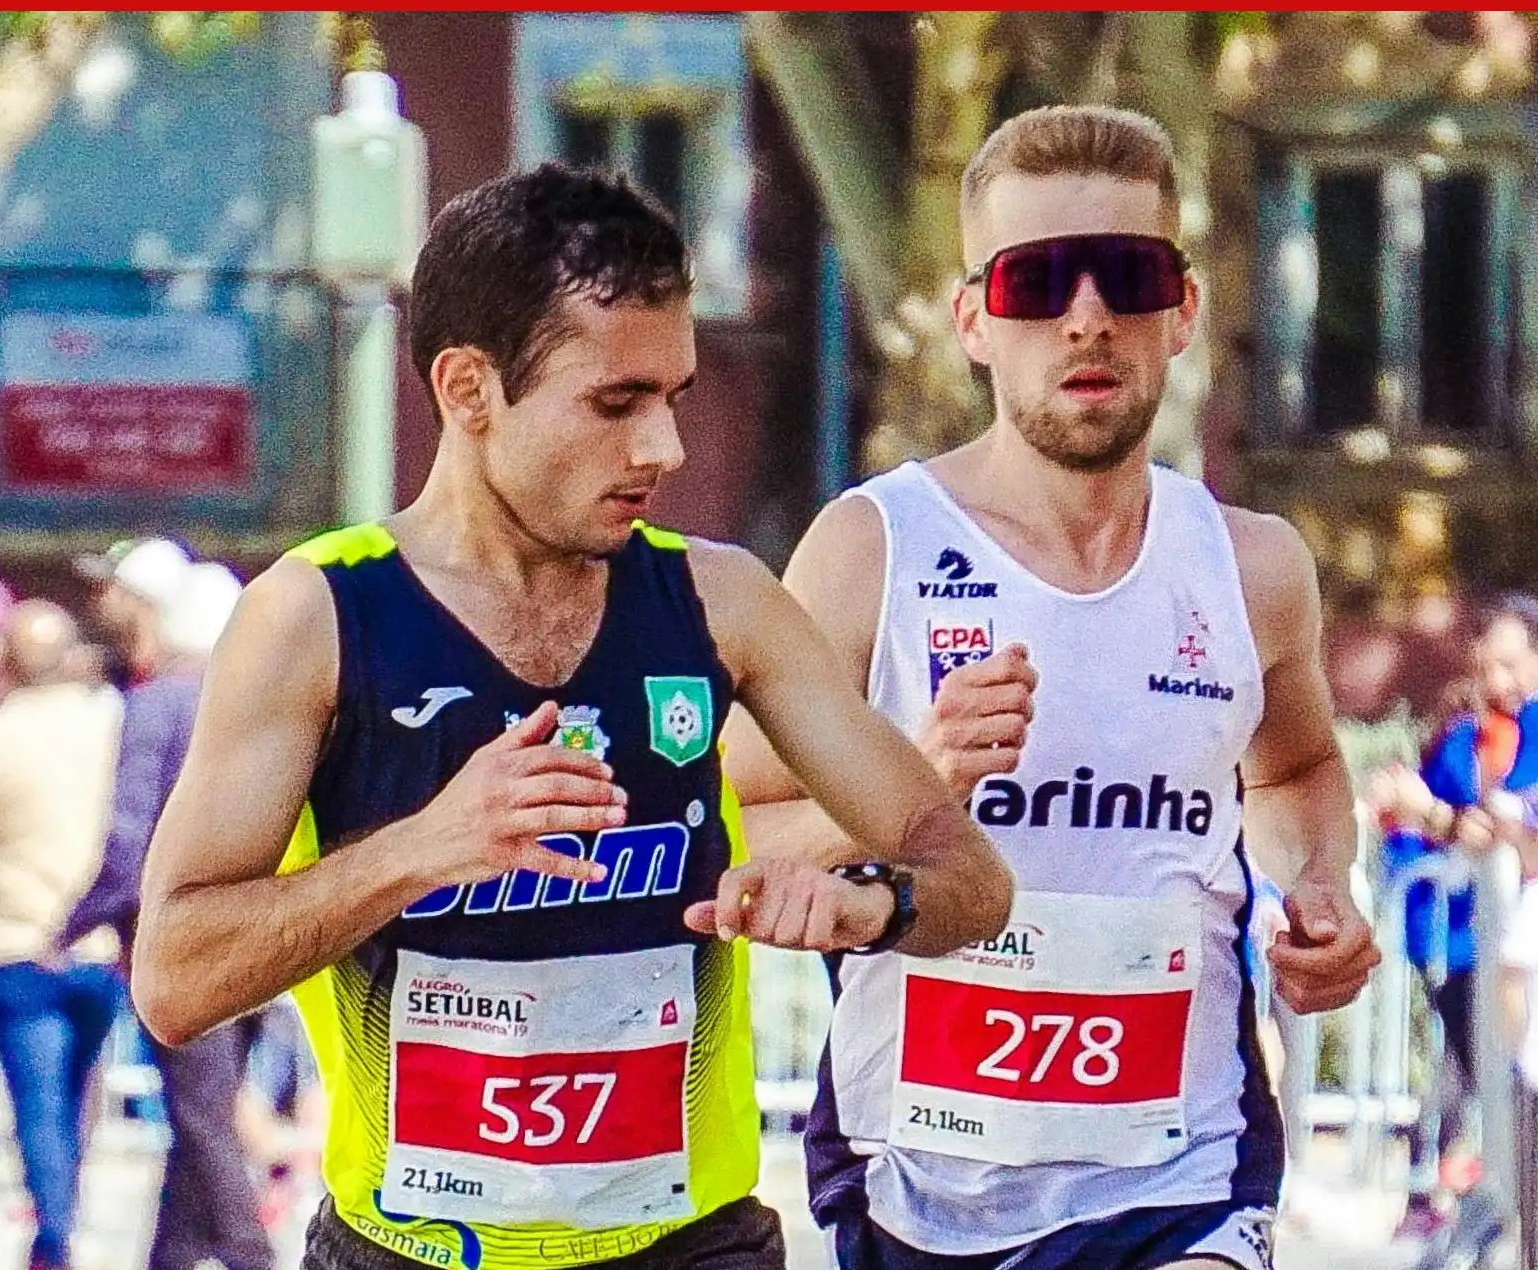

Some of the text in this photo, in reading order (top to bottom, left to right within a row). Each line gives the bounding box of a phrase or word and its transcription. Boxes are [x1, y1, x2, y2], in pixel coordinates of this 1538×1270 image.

[918, 581, 998, 598] VIATOR
[933, 627, 989, 649] CPA
[1148, 673, 1234, 701] Marinha
[977, 765, 1212, 836] arinha
[407, 988, 528, 1022] SETÚBAL
[976, 1009, 1124, 1086] 278
[478, 1072, 617, 1147] 537
[908, 1104, 986, 1137] 21,1km
[401, 1167, 484, 1197] 21,1km
